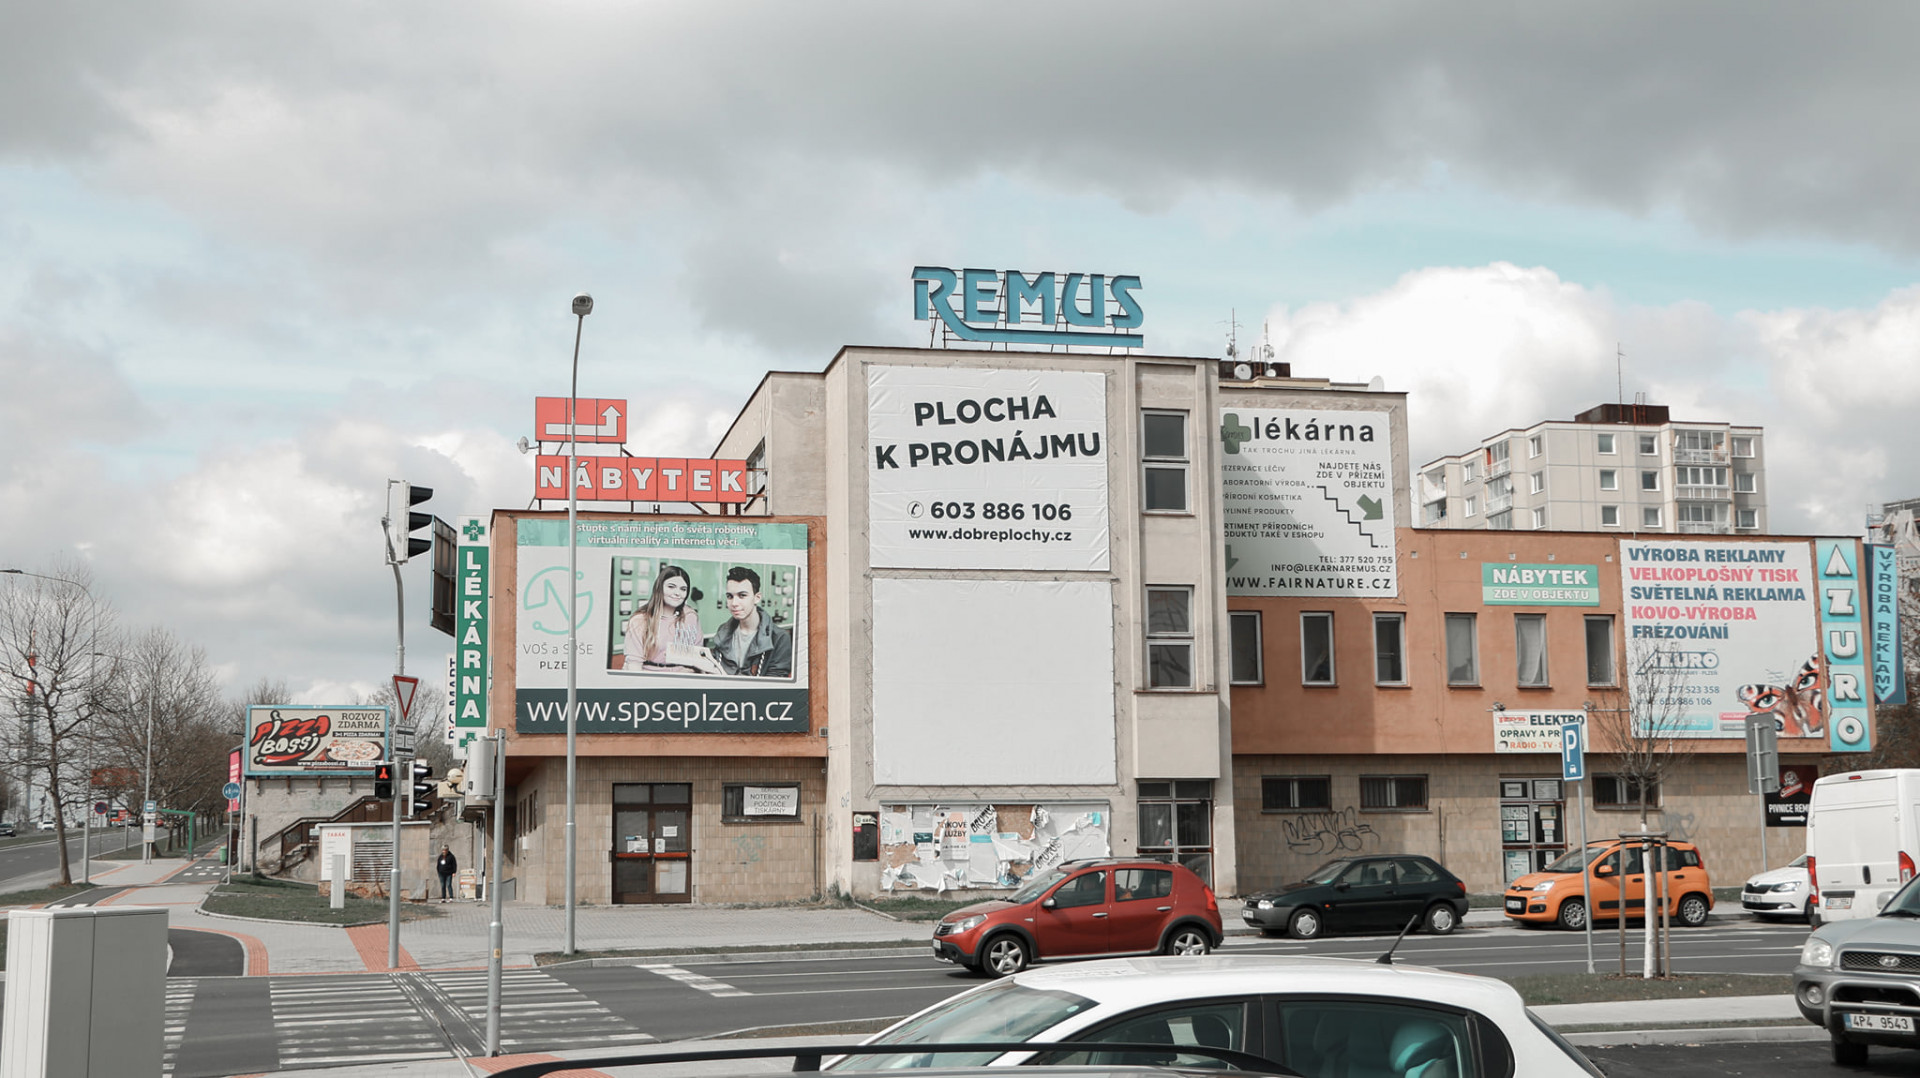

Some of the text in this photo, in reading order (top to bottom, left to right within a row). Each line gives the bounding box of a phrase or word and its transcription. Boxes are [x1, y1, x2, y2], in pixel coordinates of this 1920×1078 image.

[911, 266, 1144, 348] REMUS
[914, 395, 1056, 426] PLOCHA
[1254, 417, 1374, 442] lékárna
[875, 430, 1101, 469] K PRONÁJMU
[1319, 461, 1381, 471] NAJDETE NÁS
[540, 461, 742, 492] NÁBYTEK
[1316, 470, 1385, 480] ZDE V PŘÍZEMÍ
[1223, 478, 1306, 487] ABORATORNÍ VÝROBA
[1343, 480, 1385, 489] OBJEKTU
[1222, 493, 1256, 501] ŘÍRODNÍ
[931, 501, 1072, 520] 603 886 106
[576, 524, 608, 533] stupte
[618, 523, 642, 532] námi
[644, 524, 670, 534] nejen
[672, 524, 684, 533] do
[687, 524, 713, 533] světa
[715, 525, 757, 536] robotiky,
[1262, 521, 1313, 531] PŘÍRODNÍCH
[587, 535, 629, 544] virtuální
[631, 535, 661, 546] reality
[672, 536, 716, 546] internetu
[719, 537, 740, 546] věci.
[909, 527, 1072, 543] www.dobreplochy.cz
[1223, 529, 1257, 538] ODUKTŮ
[1261, 530, 1280, 538] TAKÉ
[1292, 531, 1324, 539] ESHOPU
[1319, 556, 1393, 564] TEL: 377 520 755
[1628, 545, 1785, 563] VÝROBA REKLAMY
[1271, 563, 1391, 573] INFO@LEKARNAREMUS.CZ
[1629, 565, 1799, 582] VELKOPLOŠNÝ TISK
[1492, 565, 1589, 585] NÁBYTEK
[1494, 589, 1589, 600] ZDE V OBJEKTU
[1630, 584, 1806, 601] SVĚTELNÁ REKLAMA
[1631, 604, 1757, 620] KOVO-VÝROBA
[461, 550, 482, 719] LÉKÁRNA
[1632, 623, 1729, 639] FRÉZOVÁNÍ
[522, 642, 593, 655] VOŠ a SŠE
[1824, 543, 1864, 745] AZURO
[539, 660, 568, 670] PLZE
[1875, 622, 1891, 695] REKLAMY
[1685, 686, 1701, 694] 523
[1704, 686, 1720, 694] 358
[341, 712, 381, 721] ROZVOZ
[526, 693, 794, 728] www.spseplzen.cz
[338, 721, 380, 729] ZDARMA
[1500, 730, 1537, 738] OPRAVY
[1539, 730, 1545, 738] A
[1510, 741, 1537, 749] RADIO
[1543, 741, 1552, 749] TV
[1565, 730, 1577, 762] P
[1768, 803, 1809, 813] PIVNICE REM
[1853, 1016, 1873, 1028] 4P4
[1879, 1017, 1909, 1030] 9543
